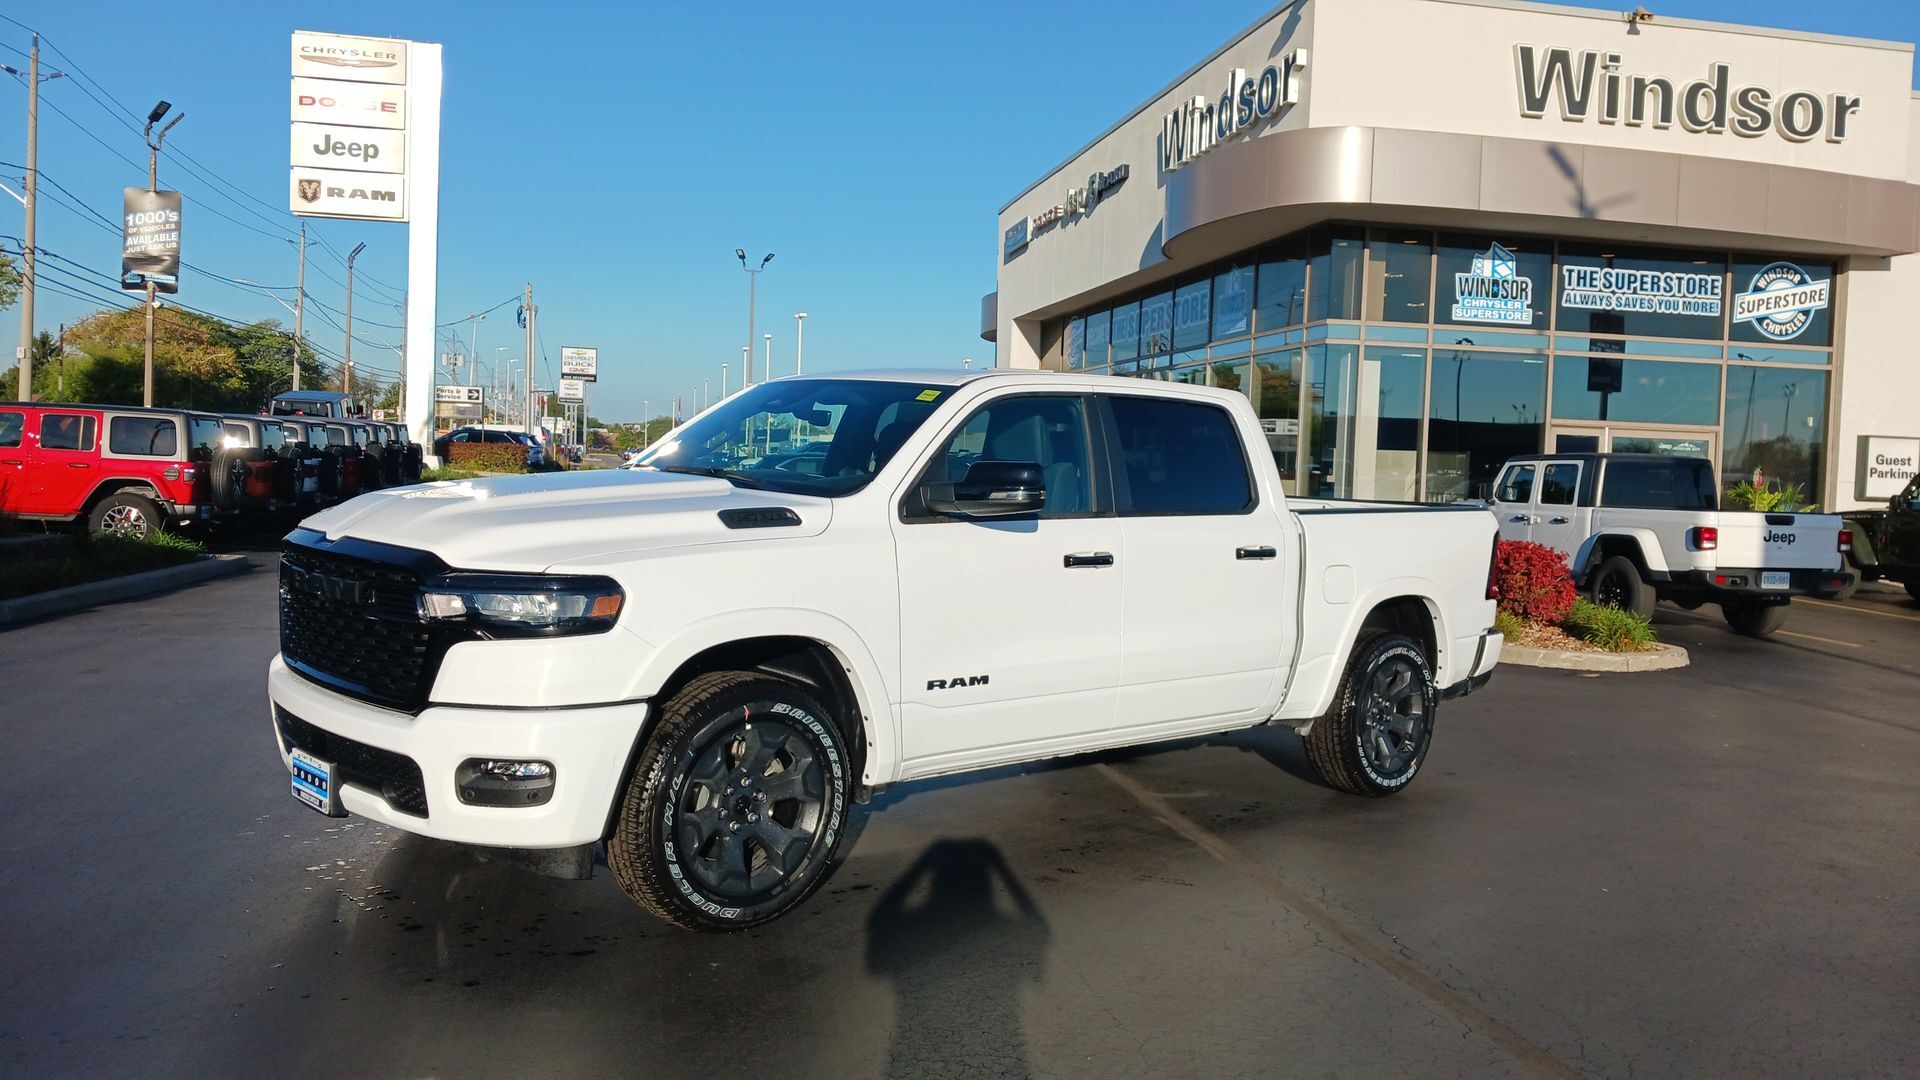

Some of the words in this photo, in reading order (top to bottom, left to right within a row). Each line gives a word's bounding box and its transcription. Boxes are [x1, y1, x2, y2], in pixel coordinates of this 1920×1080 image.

[301, 46, 397, 60] CHRYSLER
[1513, 42, 1862, 144] Windsor
[299, 95, 397, 113] DOE
[1162, 48, 1308, 173] Windsor
[313, 134, 379, 162] Jeep
[326, 186, 396, 202] RAM
[127, 210, 178, 225] 1000's
[140, 223, 176, 232] VEHICLES
[127, 232, 178, 246] AVAILABLE
[127, 245, 145, 253] JUST
[1458, 276, 1529, 300] WINDSOR
[1566, 269, 1599, 288] THE
[1602, 271, 1720, 296] SUPERSTORE
[1757, 268, 1802, 289] WINDSOR
[1463, 299, 1522, 309] CHRYSLER
[1564, 293, 1612, 307] ALWAYS
[1615, 296, 1654, 310] SAVES
[1655, 299, 1680, 311] YOU
[1682, 301, 1719, 313] MORE!
[1738, 288, 1825, 315] SUPERSTORE
[1455, 308, 1529, 320] SUPERSTORE
[1762, 313, 1807, 335] CHRYSLER
[1876, 454, 1912, 466] Guest
[1763, 530, 1796, 545] Jeep
[926, 675, 989, 691] RAM
[770, 702, 844, 848] BRIDGESTONE
[664, 773, 684, 826] H/L
[664, 841, 744, 919] DUELER
